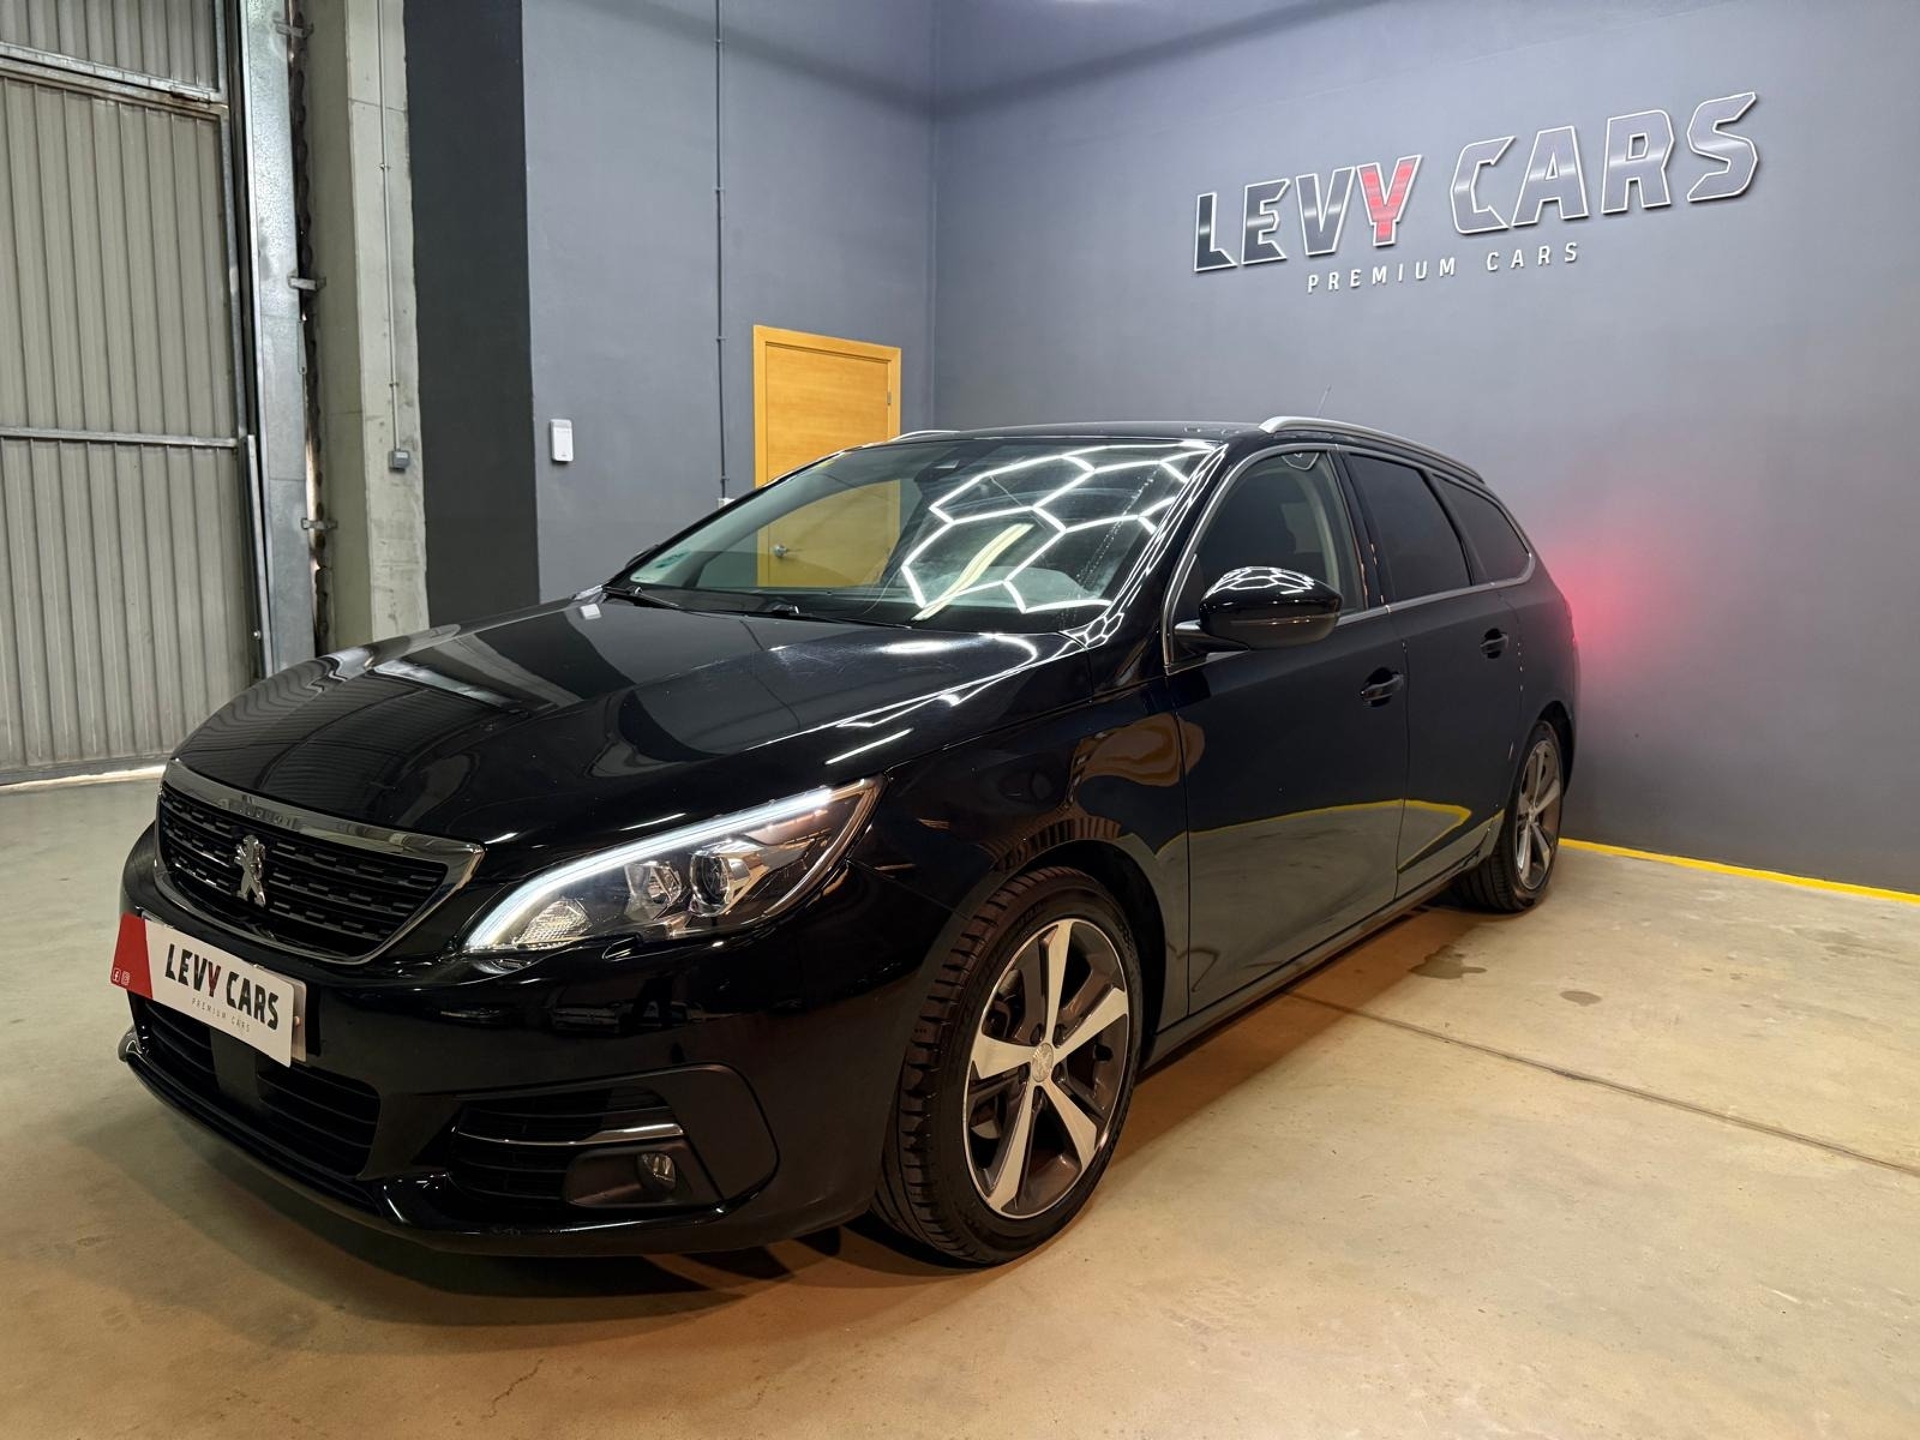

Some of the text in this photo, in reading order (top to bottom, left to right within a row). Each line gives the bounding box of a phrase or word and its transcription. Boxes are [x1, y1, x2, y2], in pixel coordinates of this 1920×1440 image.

[1193, 91, 1758, 272] LEVY CARS
[1307, 241, 1579, 294] PREMIUM CARS
[164, 943, 279, 1030] LEVY CARS
[192, 997, 226, 1019] PREMIUM
